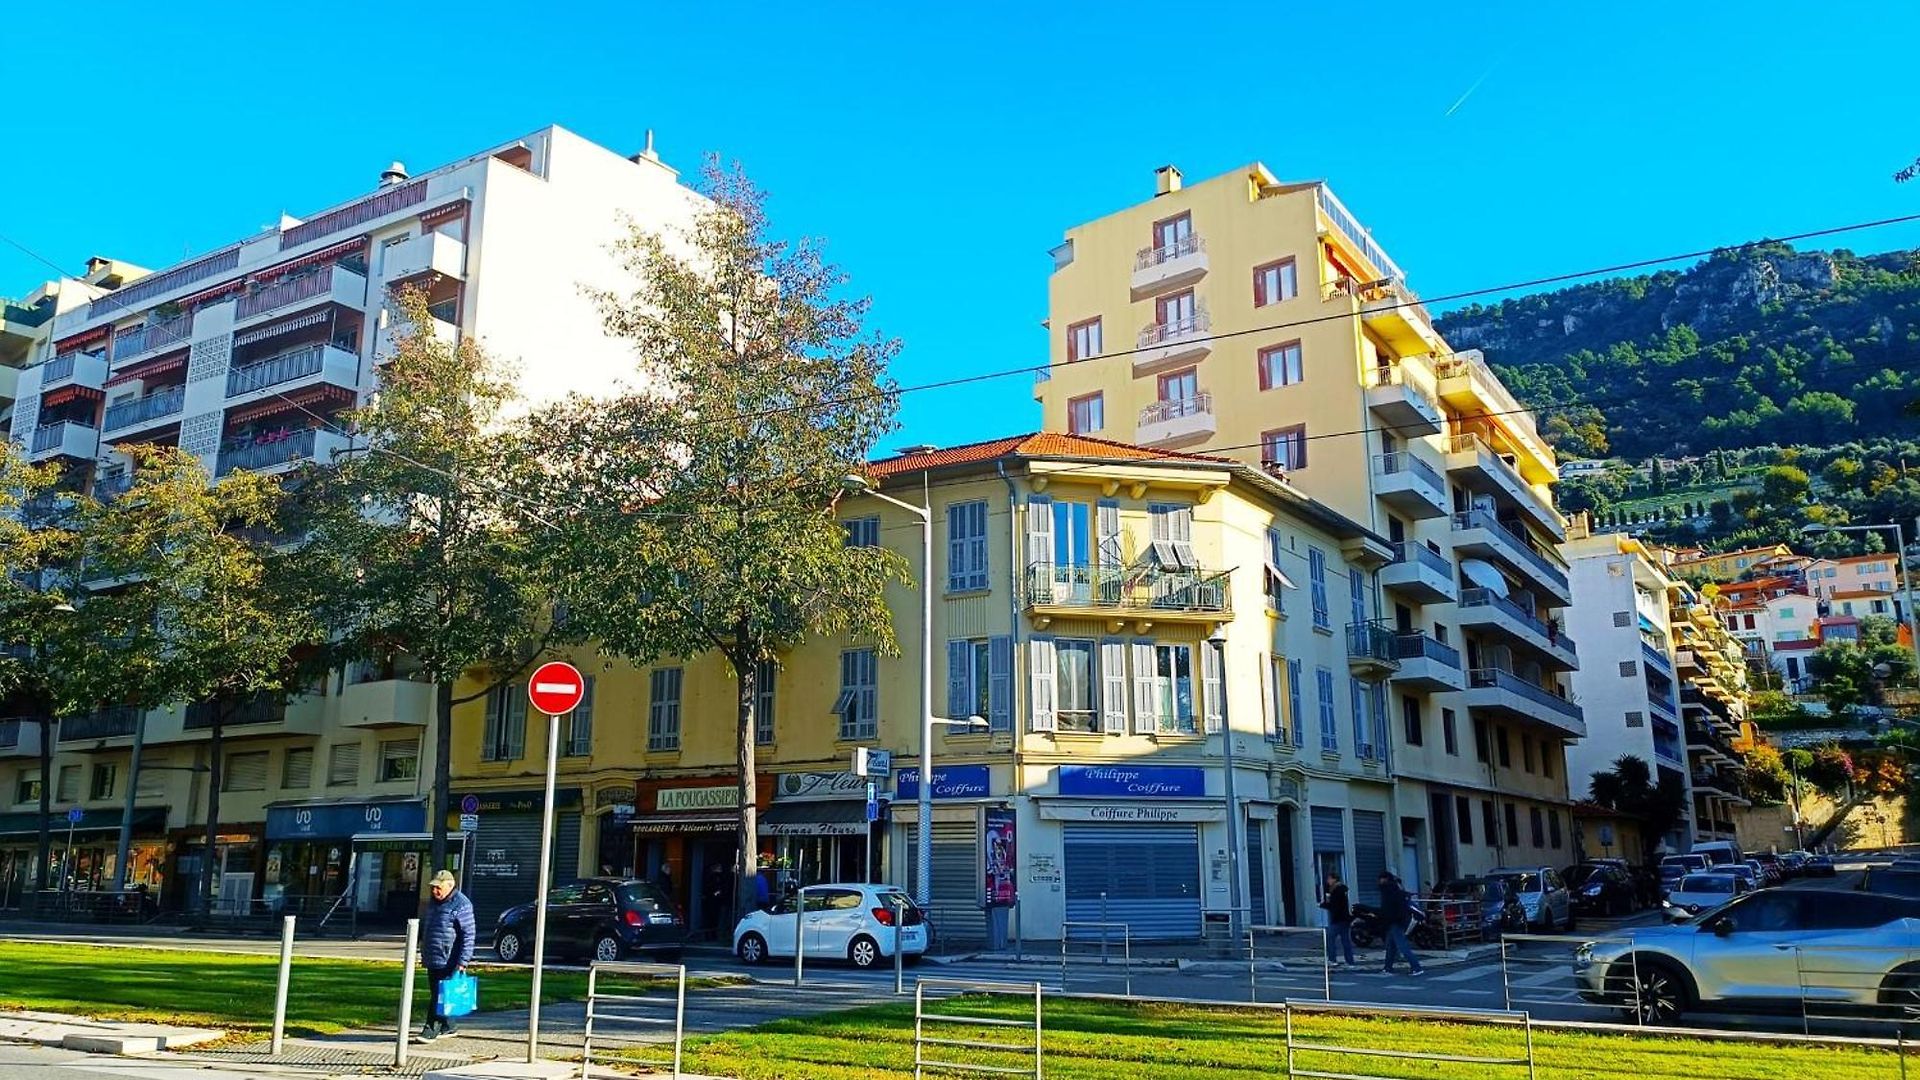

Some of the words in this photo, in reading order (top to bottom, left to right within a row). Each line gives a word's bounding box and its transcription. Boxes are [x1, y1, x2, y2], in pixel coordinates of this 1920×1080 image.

[1085, 768, 1139, 783] Philippe
[936, 782, 984, 795] Coiffure
[1127, 783, 1182, 795] Coiffure
[662, 790, 674, 808] LA
[1091, 807, 1135, 819] Coiffure
[1137, 807, 1178, 820] Philippe
[770, 824, 812, 835] Thomas
[817, 823, 856, 834] Fleurs
